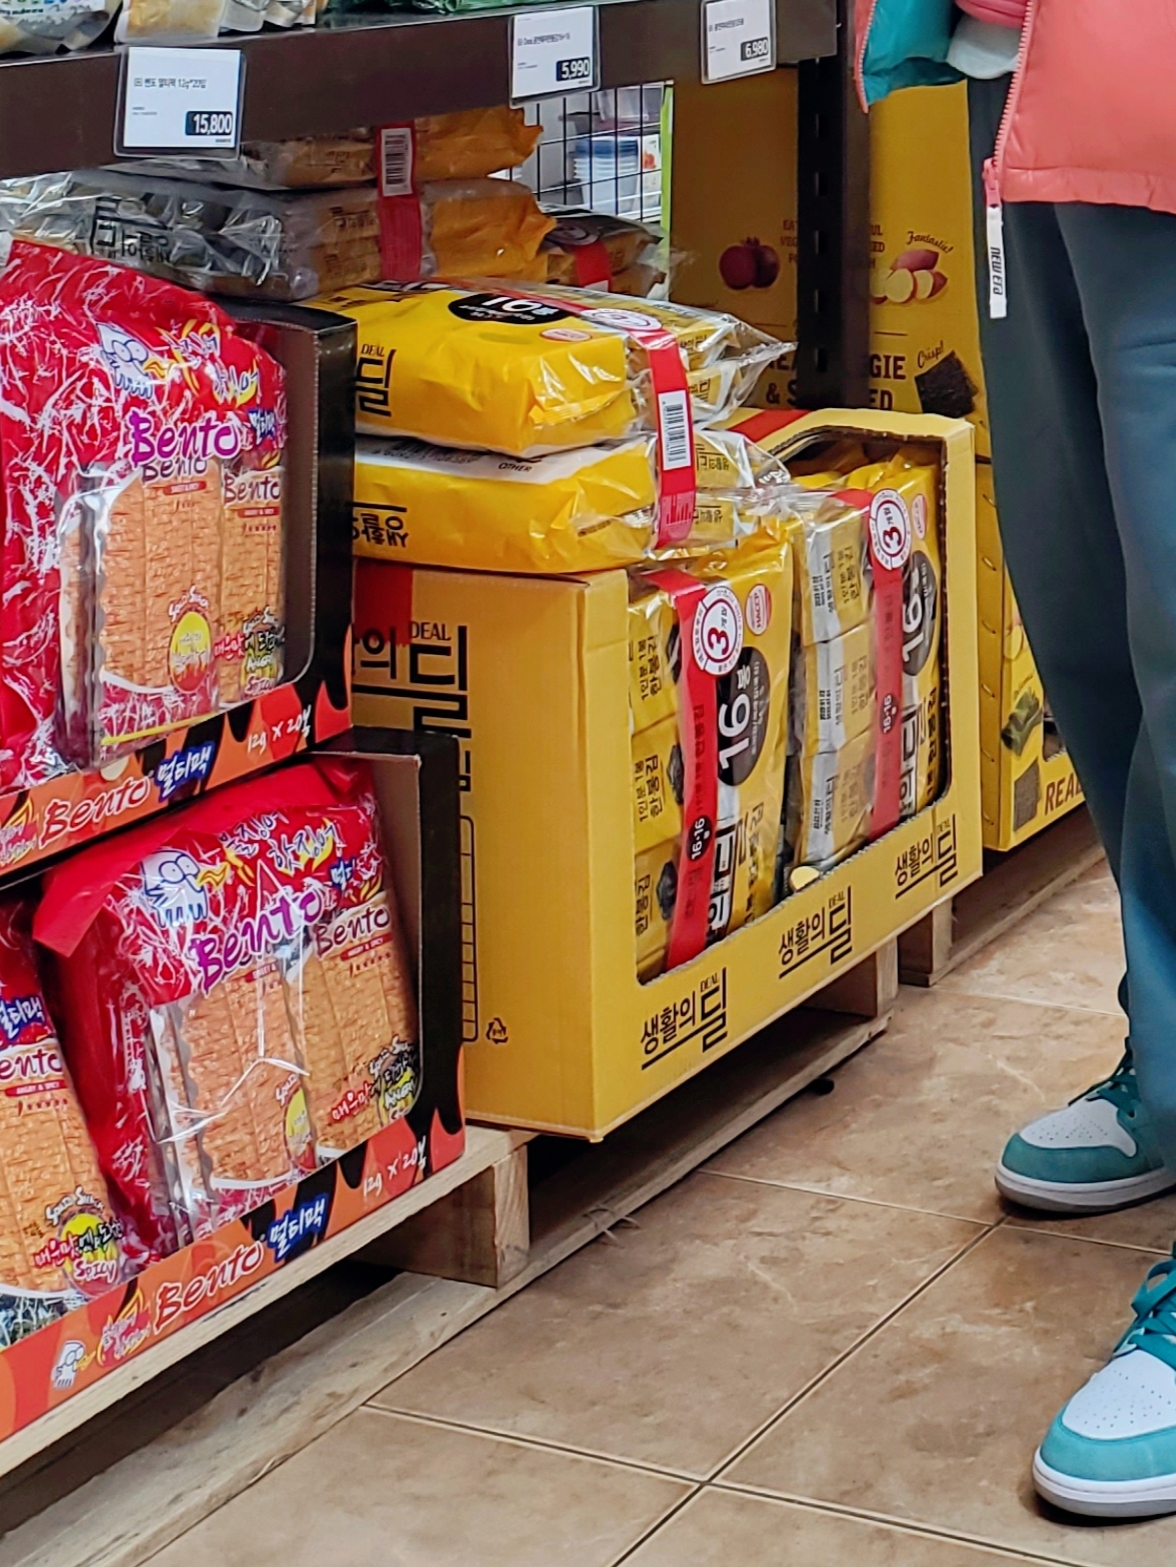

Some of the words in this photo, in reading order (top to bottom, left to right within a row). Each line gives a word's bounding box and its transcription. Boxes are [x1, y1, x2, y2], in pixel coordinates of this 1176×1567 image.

[745, 37, 769, 59] 6,980
[561, 59, 590, 80] 5,990
[193, 113, 233, 135] 15,800
[361, 343, 386, 357] DEAL
[916, 340, 944, 369] Crisp!
[129, 408, 241, 470] Bento
[223, 472, 282, 506] Bento
[882, 526, 902, 549] 3
[753, 591, 762, 629] HACCP
[409, 620, 452, 642] DEAL
[708, 627, 730, 656] 3
[157, 744, 212, 798] 멀티팩
[38, 776, 151, 850] Bento
[895, 831, 934, 887] 생활의
[828, 889, 846, 908] DEAL
[188, 888, 323, 997] Bento
[312, 904, 391, 960] Bento
[778, 906, 826, 966] 생활의
[700, 972, 719, 993] DEAL
[640, 990, 697, 1055] 생활의
[363, 1170, 383, 1198] 12g
[268, 1196, 327, 1261] 멀티팩
[153, 1239, 266, 1336] Bento
